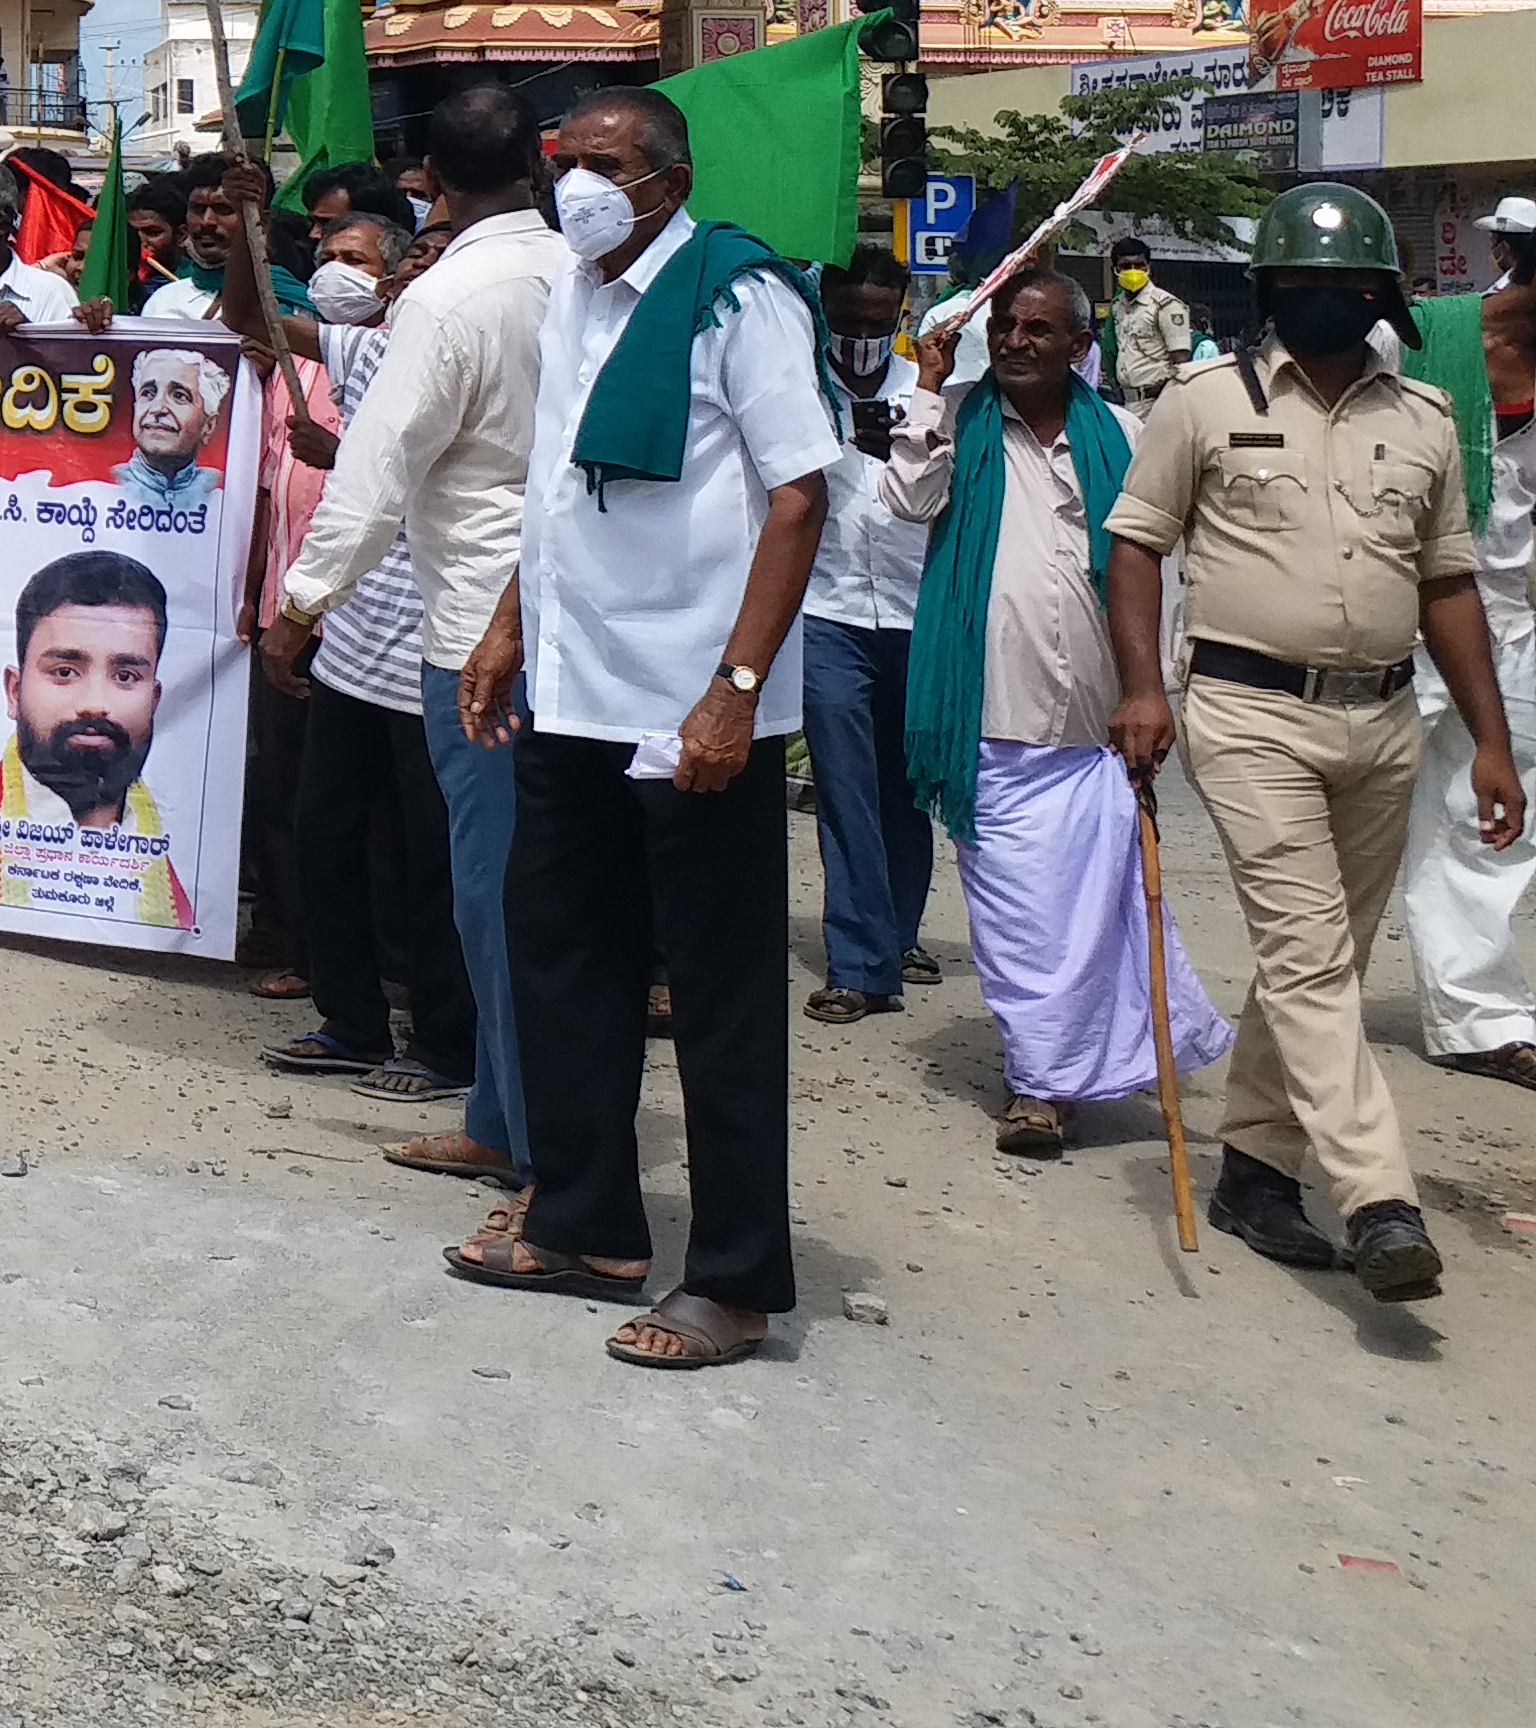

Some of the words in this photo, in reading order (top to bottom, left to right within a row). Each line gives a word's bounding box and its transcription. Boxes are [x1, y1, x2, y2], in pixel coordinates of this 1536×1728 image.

[1368, 53, 1412, 67] DIAMOND
[1365, 71, 1384, 82] TEA
[1385, 69, 1415, 81] STALL
[1206, 120, 1295, 139] DAIMOND
[927, 182, 956, 224] P
[36, 495, 98, 544] ಕಾಯ್ದೆ
[104, 502, 208, 538] ಸೇರಿದಂತೆ
[15, 818, 74, 848] ವಿಜಯ್
[80, 828, 171, 858] ಪಾಳೇಗಾರ್
[35, 846, 74, 865] ಪ್ರಧಾನ
[77, 851, 151, 873] ಕಾರ್ಯದರ್ಶಿ
[7, 863, 59, 882] ಕರ್ನಾಟಕ
[63, 869, 98, 890] ರಕ್ಷಣಾ
[31, 886, 91, 906] ತುಮಕೂರು
[94, 893, 115, 914] ಜಿಲ್ಲೆ
